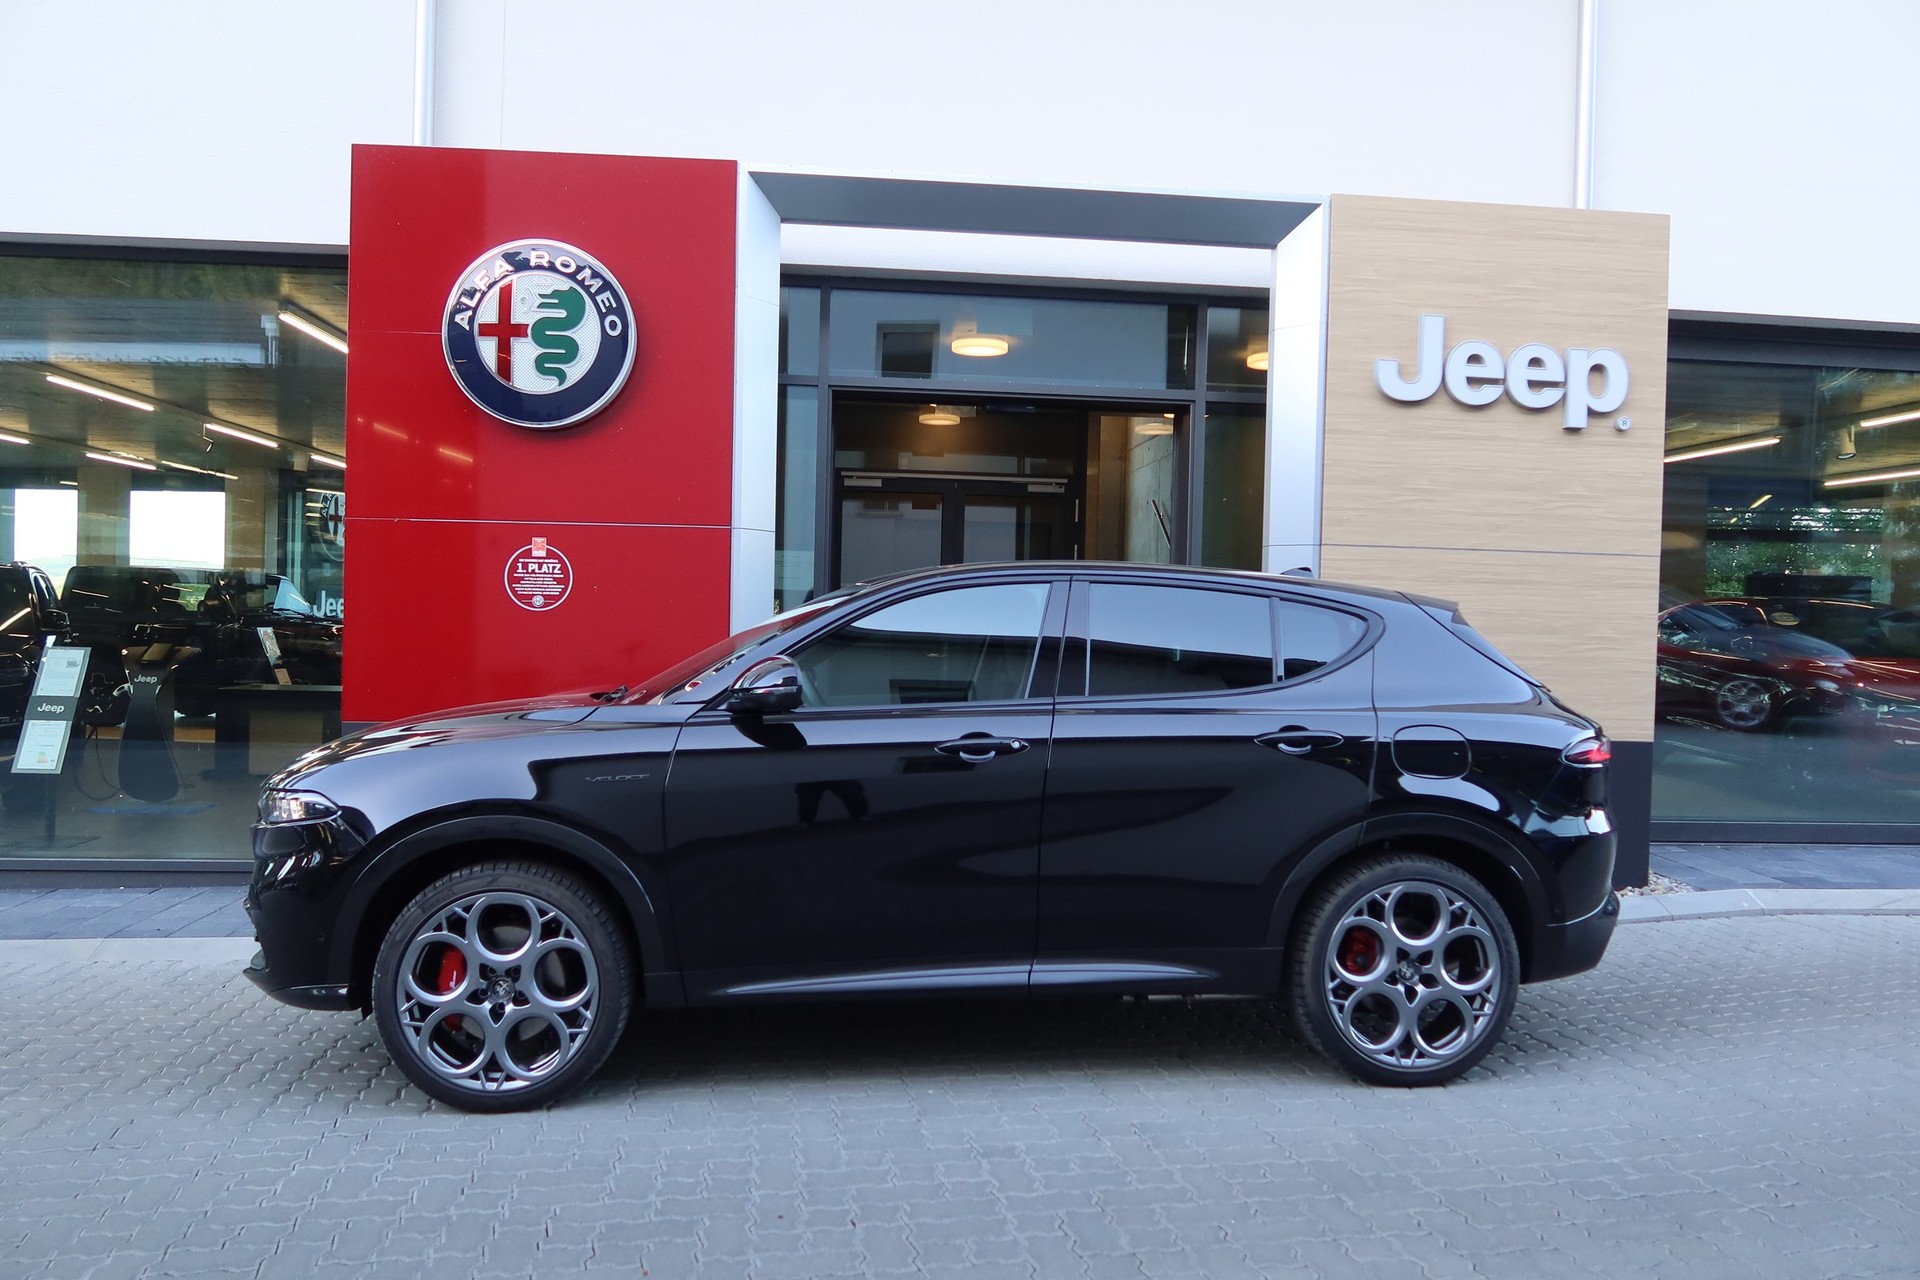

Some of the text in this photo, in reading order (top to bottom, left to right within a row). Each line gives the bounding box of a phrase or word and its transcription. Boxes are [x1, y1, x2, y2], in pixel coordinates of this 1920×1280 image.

[455, 249, 623, 337] ALFA ROMEO
[1373, 313, 1631, 431] Jeep
[516, 563, 562, 573] 1. PLATZ
[313, 590, 344, 619] Jee
[134, 674, 158, 684] Jeep
[37, 702, 65, 714] Jeep
